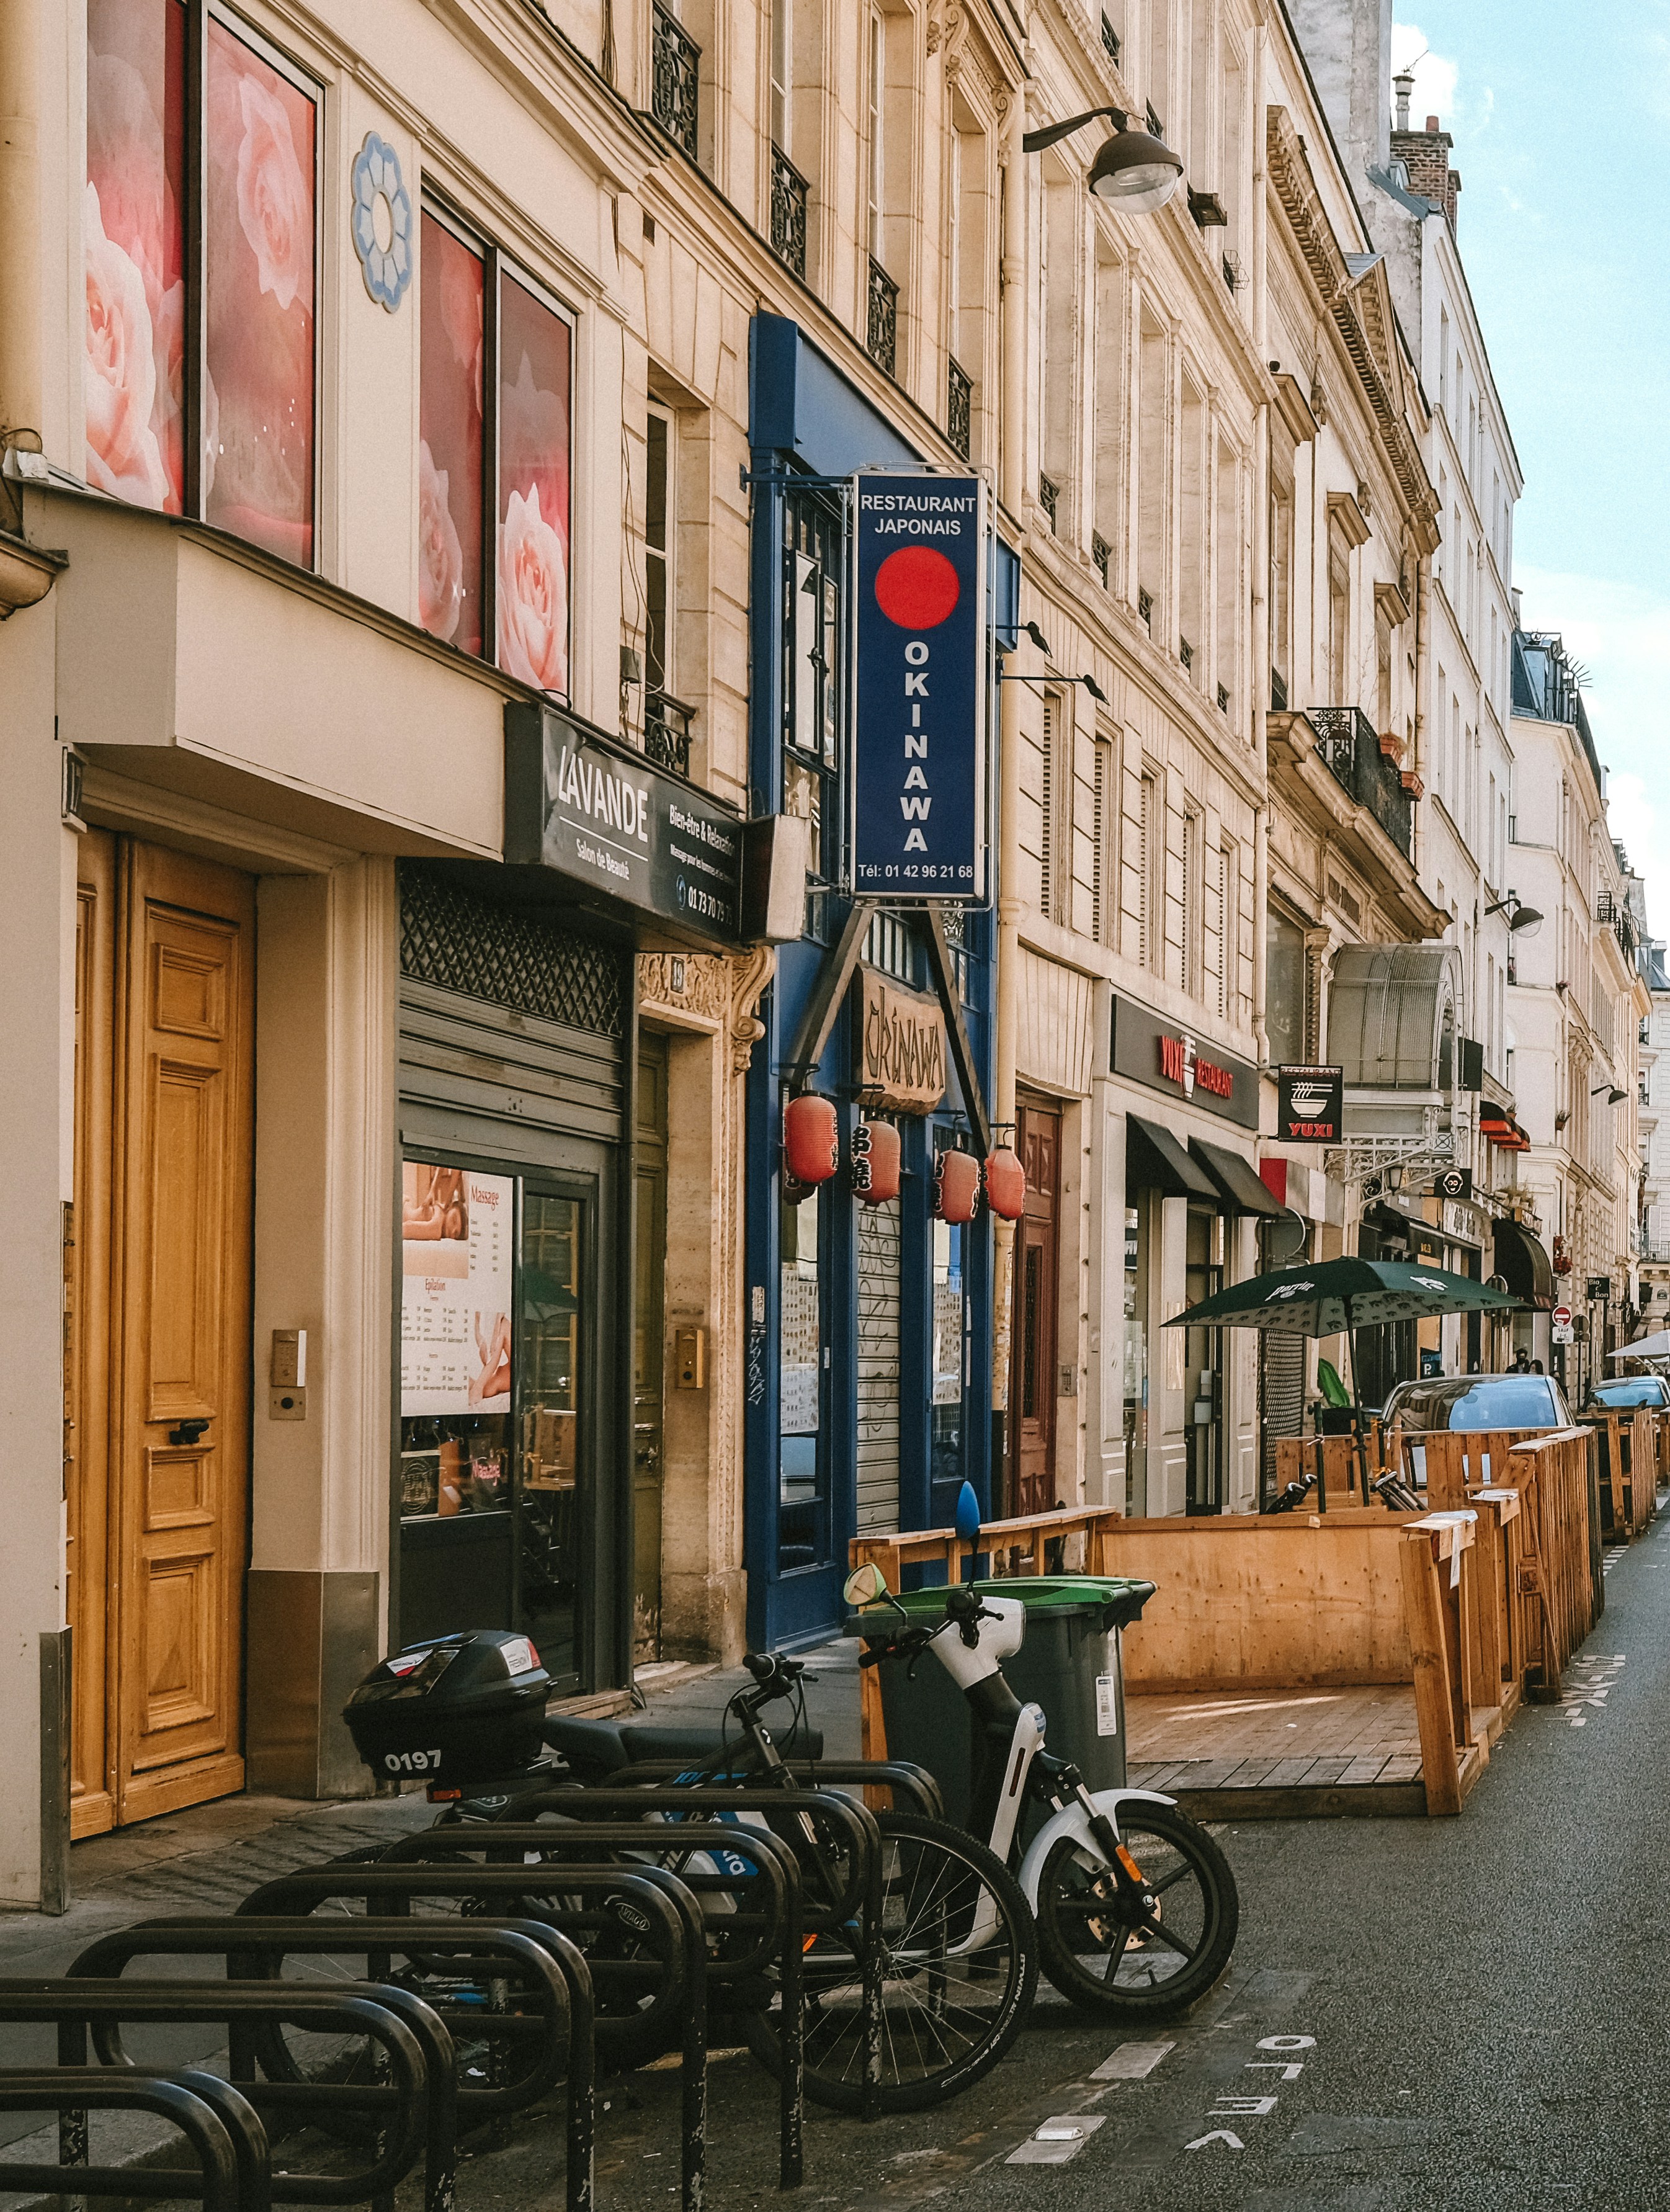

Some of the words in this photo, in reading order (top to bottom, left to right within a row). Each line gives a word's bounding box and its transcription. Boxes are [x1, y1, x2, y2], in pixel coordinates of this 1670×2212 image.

[861, 495, 976, 513] RESTAURANT
[875, 518, 961, 535] JAPONAIS
[900, 641, 931, 851] OKINAWA
[559, 746, 648, 843] LAVANDE
[670, 804, 700, 838] Bien-être
[701, 820, 706, 842] &
[576, 838, 596, 862] Salon
[597, 848, 605, 867] de
[607, 852, 630, 880] Beauté
[858, 864, 882, 877] Tél:
[885, 864, 899, 877] 01
[903, 865, 918, 877] 42
[921, 865, 937, 878] 96
[940, 866, 953, 878] 21
[958, 866, 973, 879] 68
[689, 886, 697, 909] 01
[699, 890, 707, 913] 73
[708, 895, 716, 918] 70
[1162, 1035, 1183, 1083] YUXI
[1280, 1068, 1341, 1077] RESTAURANT
[1288, 1123, 1333, 1137] YUXI
[471, 1185, 499, 1211] Massage
[385, 1750, 441, 1771] 0197
